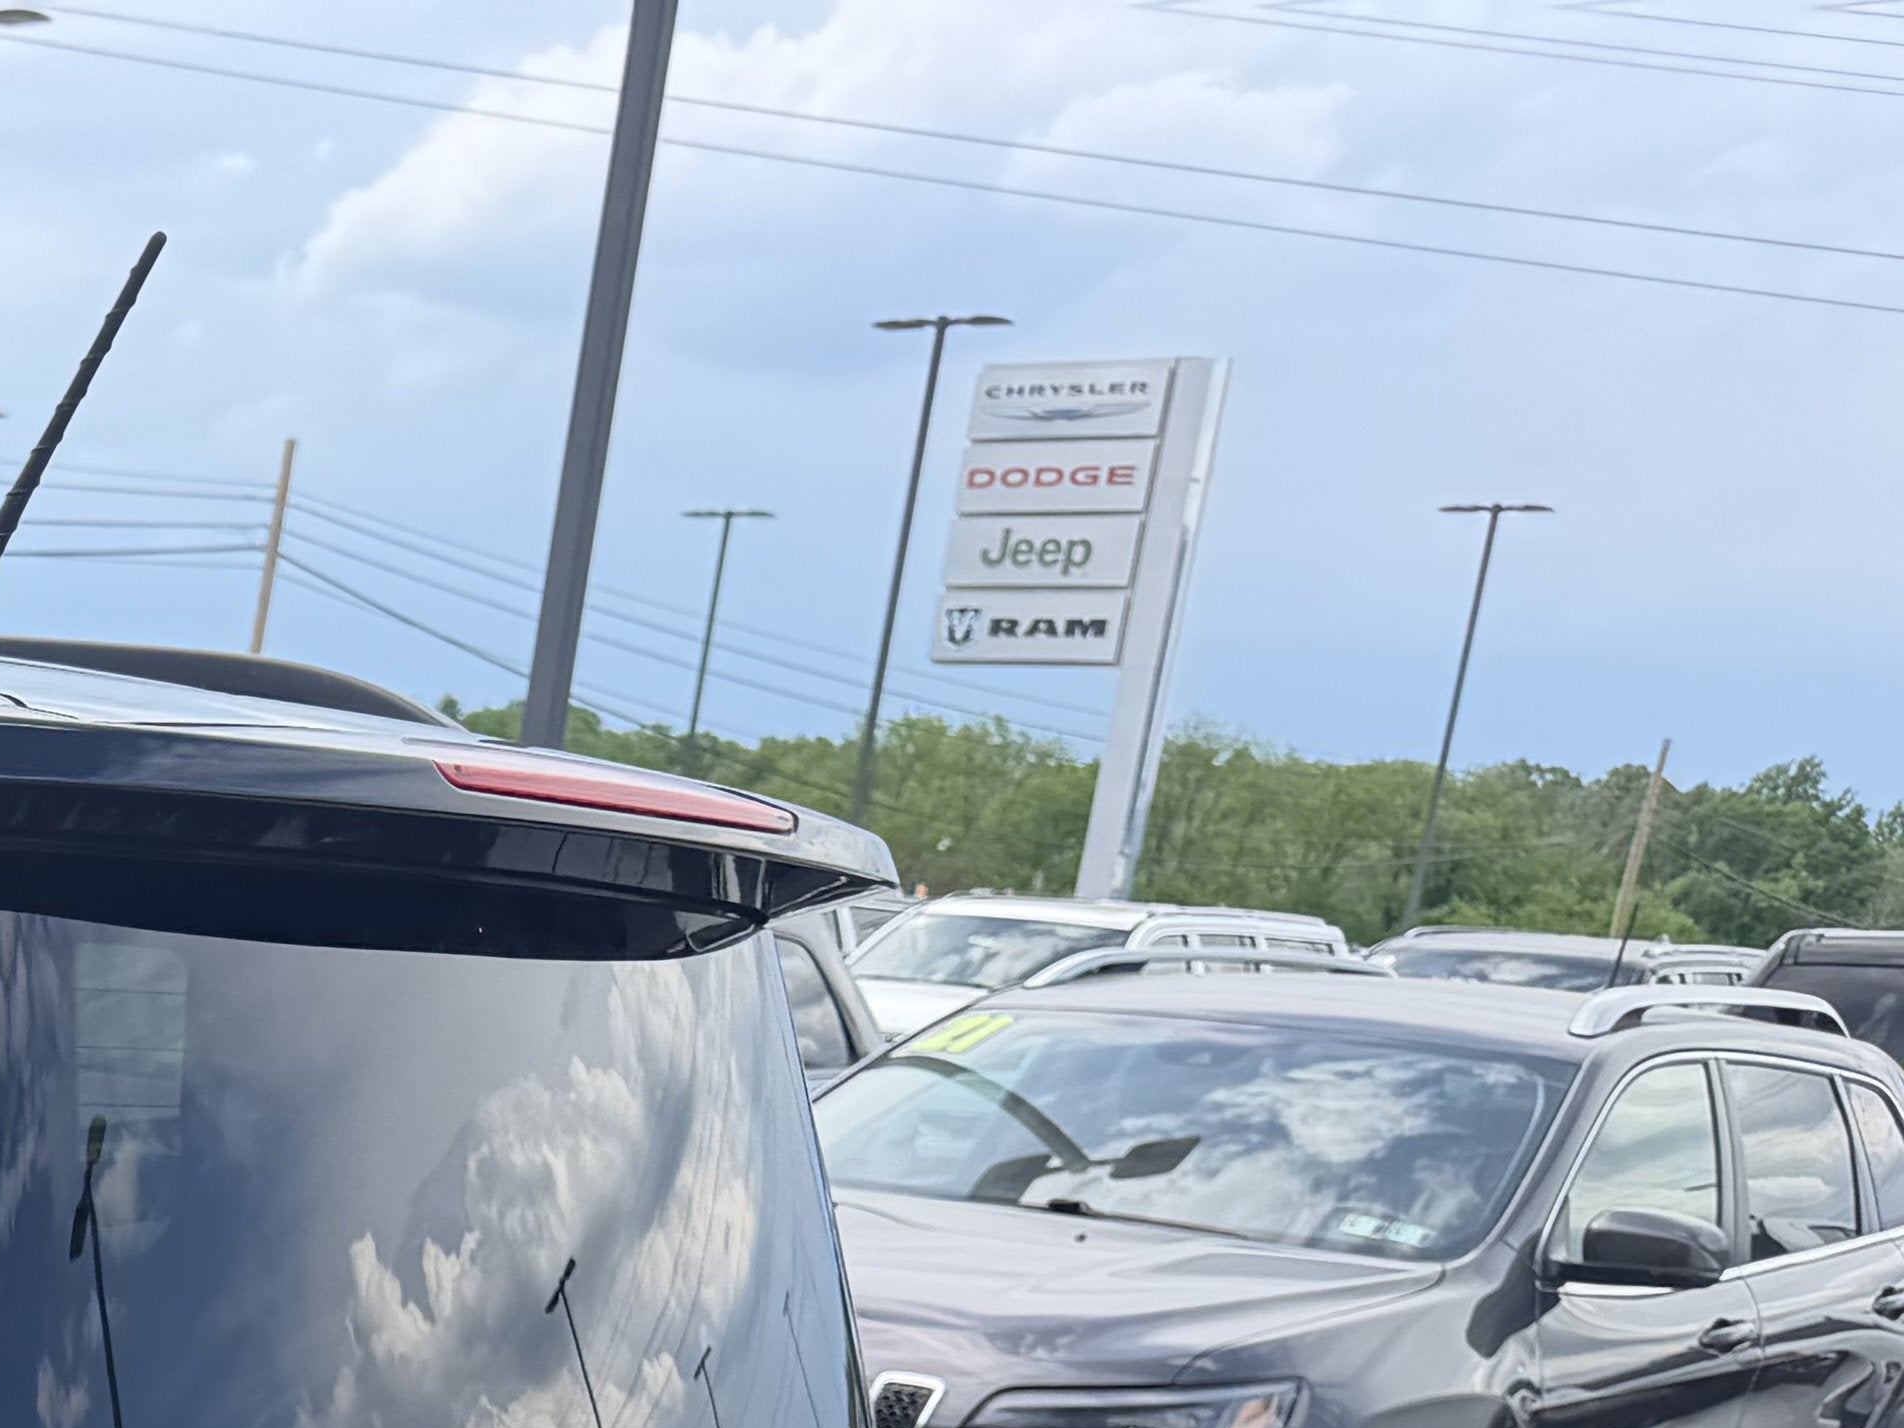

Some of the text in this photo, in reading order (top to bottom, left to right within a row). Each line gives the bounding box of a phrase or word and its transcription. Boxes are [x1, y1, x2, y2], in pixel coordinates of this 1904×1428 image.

[984, 380, 1150, 399] CHRYSLER
[964, 464, 1137, 489] DODGE
[979, 528, 1092, 576] Jeep
[988, 617, 1107, 639] RAM
